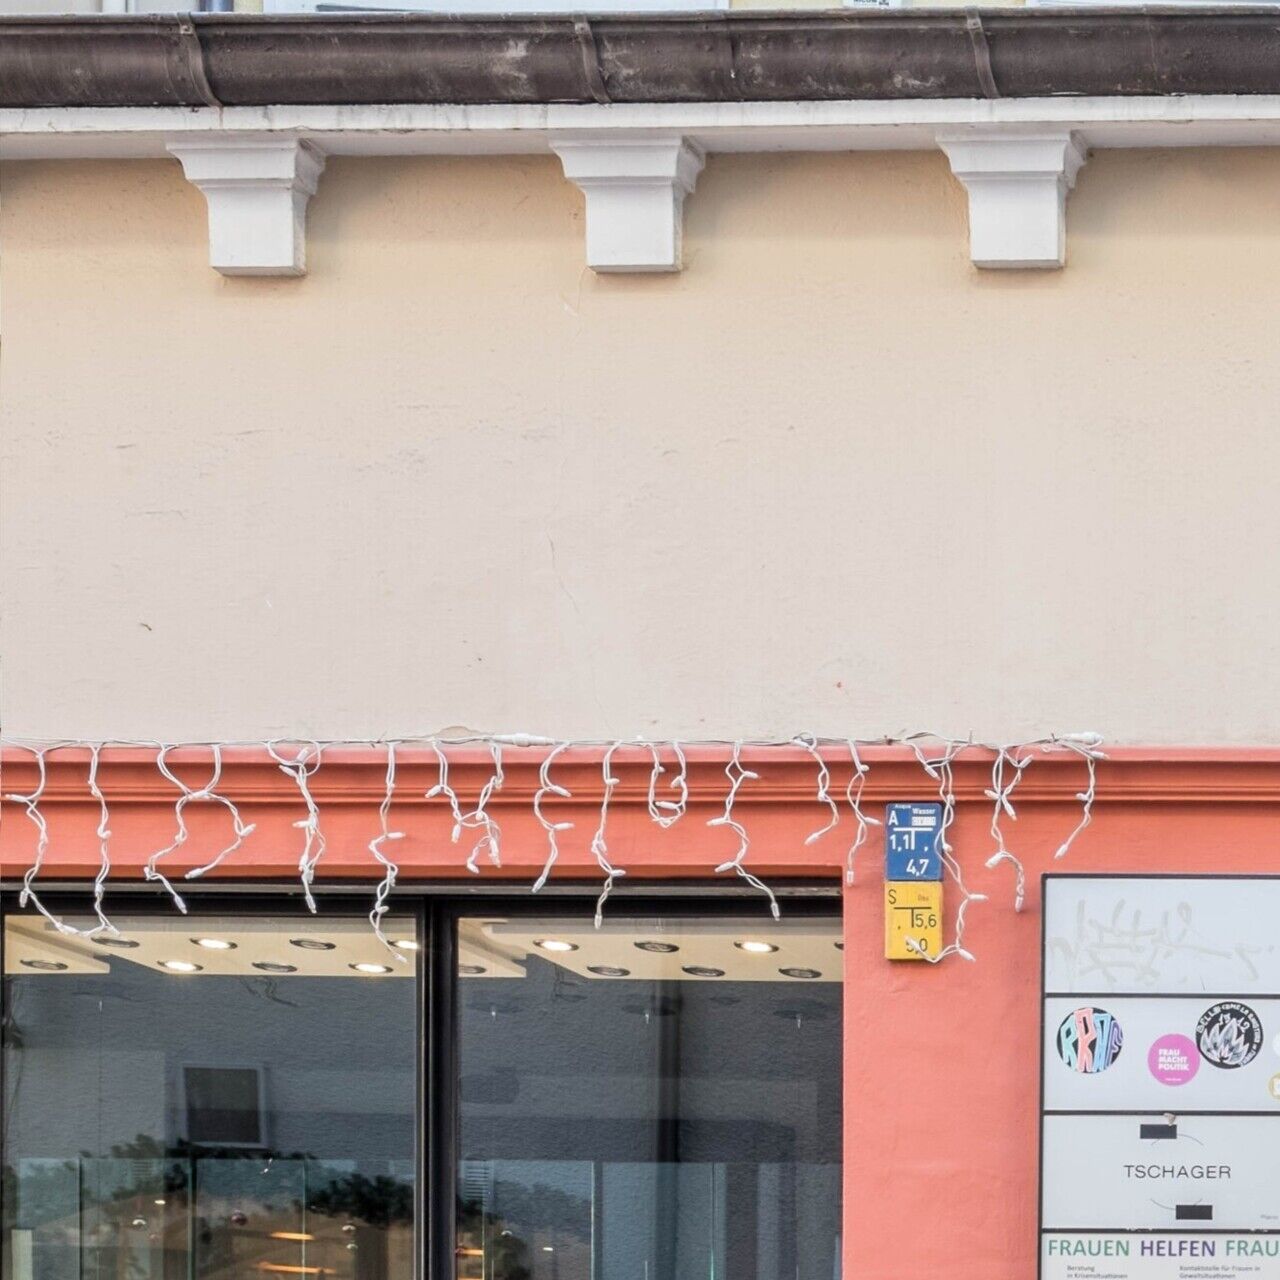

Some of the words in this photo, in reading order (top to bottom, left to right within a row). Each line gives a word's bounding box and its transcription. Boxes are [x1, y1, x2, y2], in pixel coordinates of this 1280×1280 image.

[888, 810, 899, 826] A
[906, 858, 929, 876] 4,7
[888, 889, 897, 905] S
[916, 913, 937, 930] 5,6
[1124, 1165, 1231, 1179] TSCHAGER
[1048, 1240, 1130, 1257] FRAUEN
[1141, 1240, 1216, 1257] HELFEN
